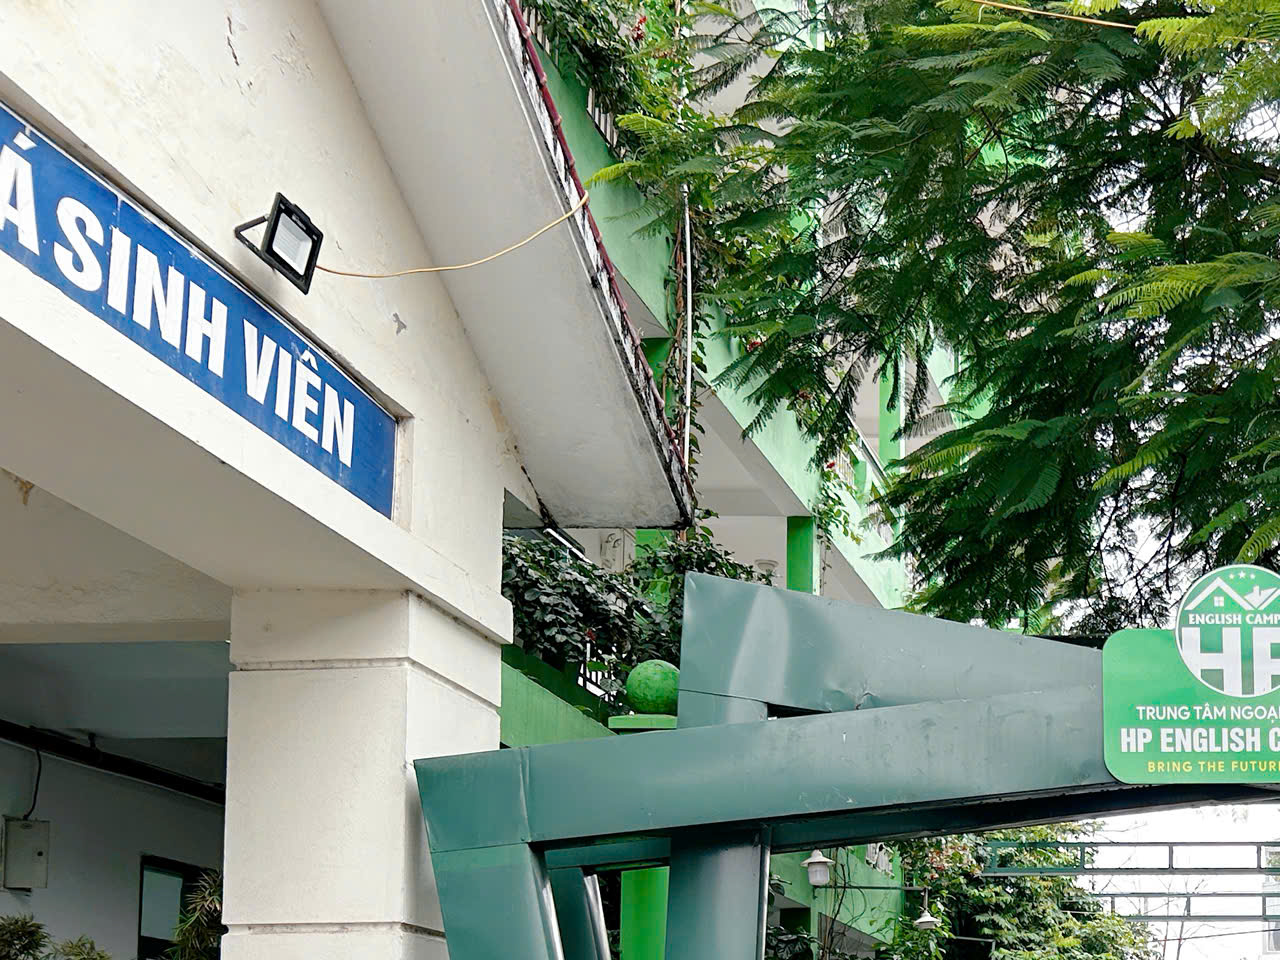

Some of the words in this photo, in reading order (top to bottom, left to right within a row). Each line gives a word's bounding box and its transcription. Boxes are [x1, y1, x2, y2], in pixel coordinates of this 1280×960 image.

[53, 196, 228, 378] SINH
[243, 318, 355, 467] VIÊN
[1188, 613, 1242, 625] ENGLISH
[1136, 705, 1190, 721] TRUNG
[1194, 703, 1226, 720] TÂM
[1120, 728, 1152, 753] HP
[1160, 727, 1261, 753] ENGLISH
[1148, 761, 1192, 773] BRING
[1198, 761, 1224, 772] THE
